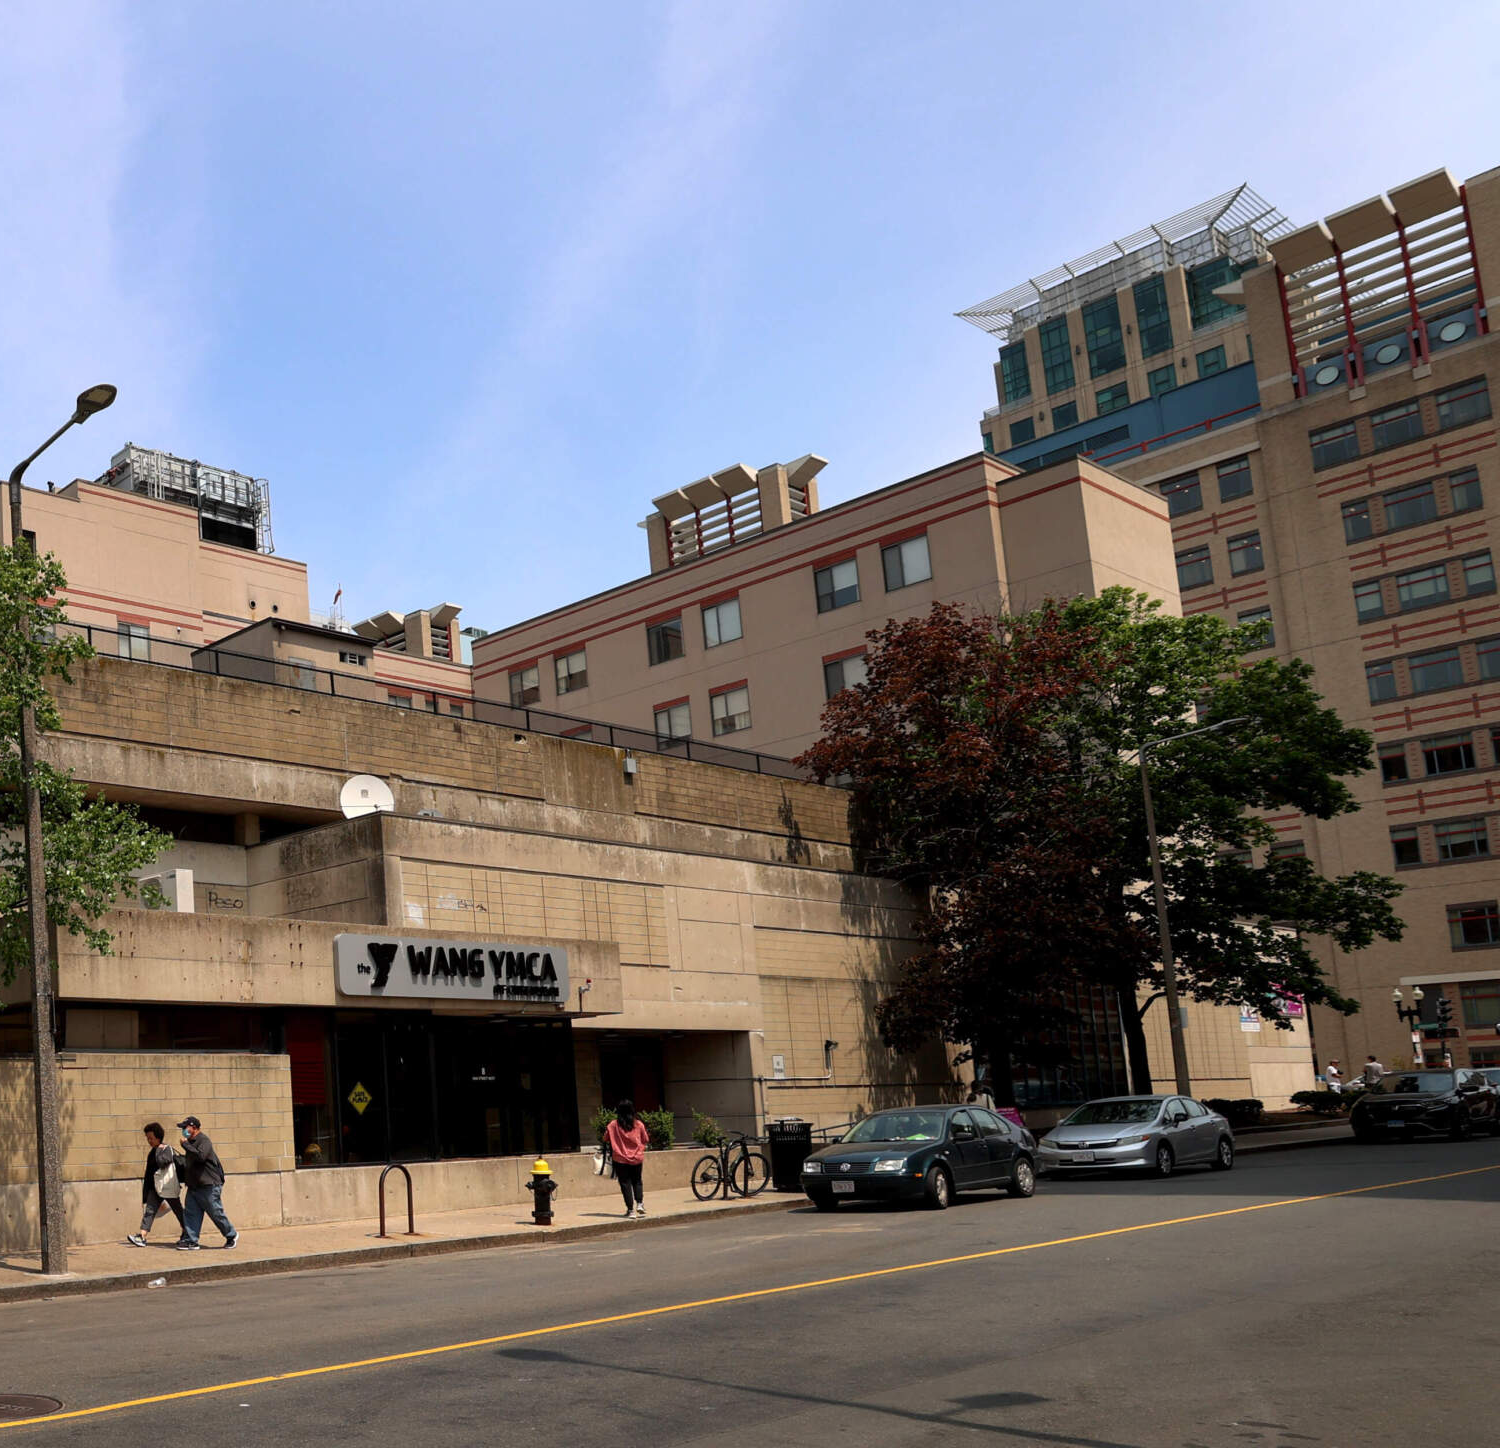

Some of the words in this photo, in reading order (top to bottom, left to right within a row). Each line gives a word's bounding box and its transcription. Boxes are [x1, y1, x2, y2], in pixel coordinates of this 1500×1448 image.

[357, 962, 371, 976] the
[406, 945, 485, 978] WANG
[488, 950, 558, 982] YMCA
